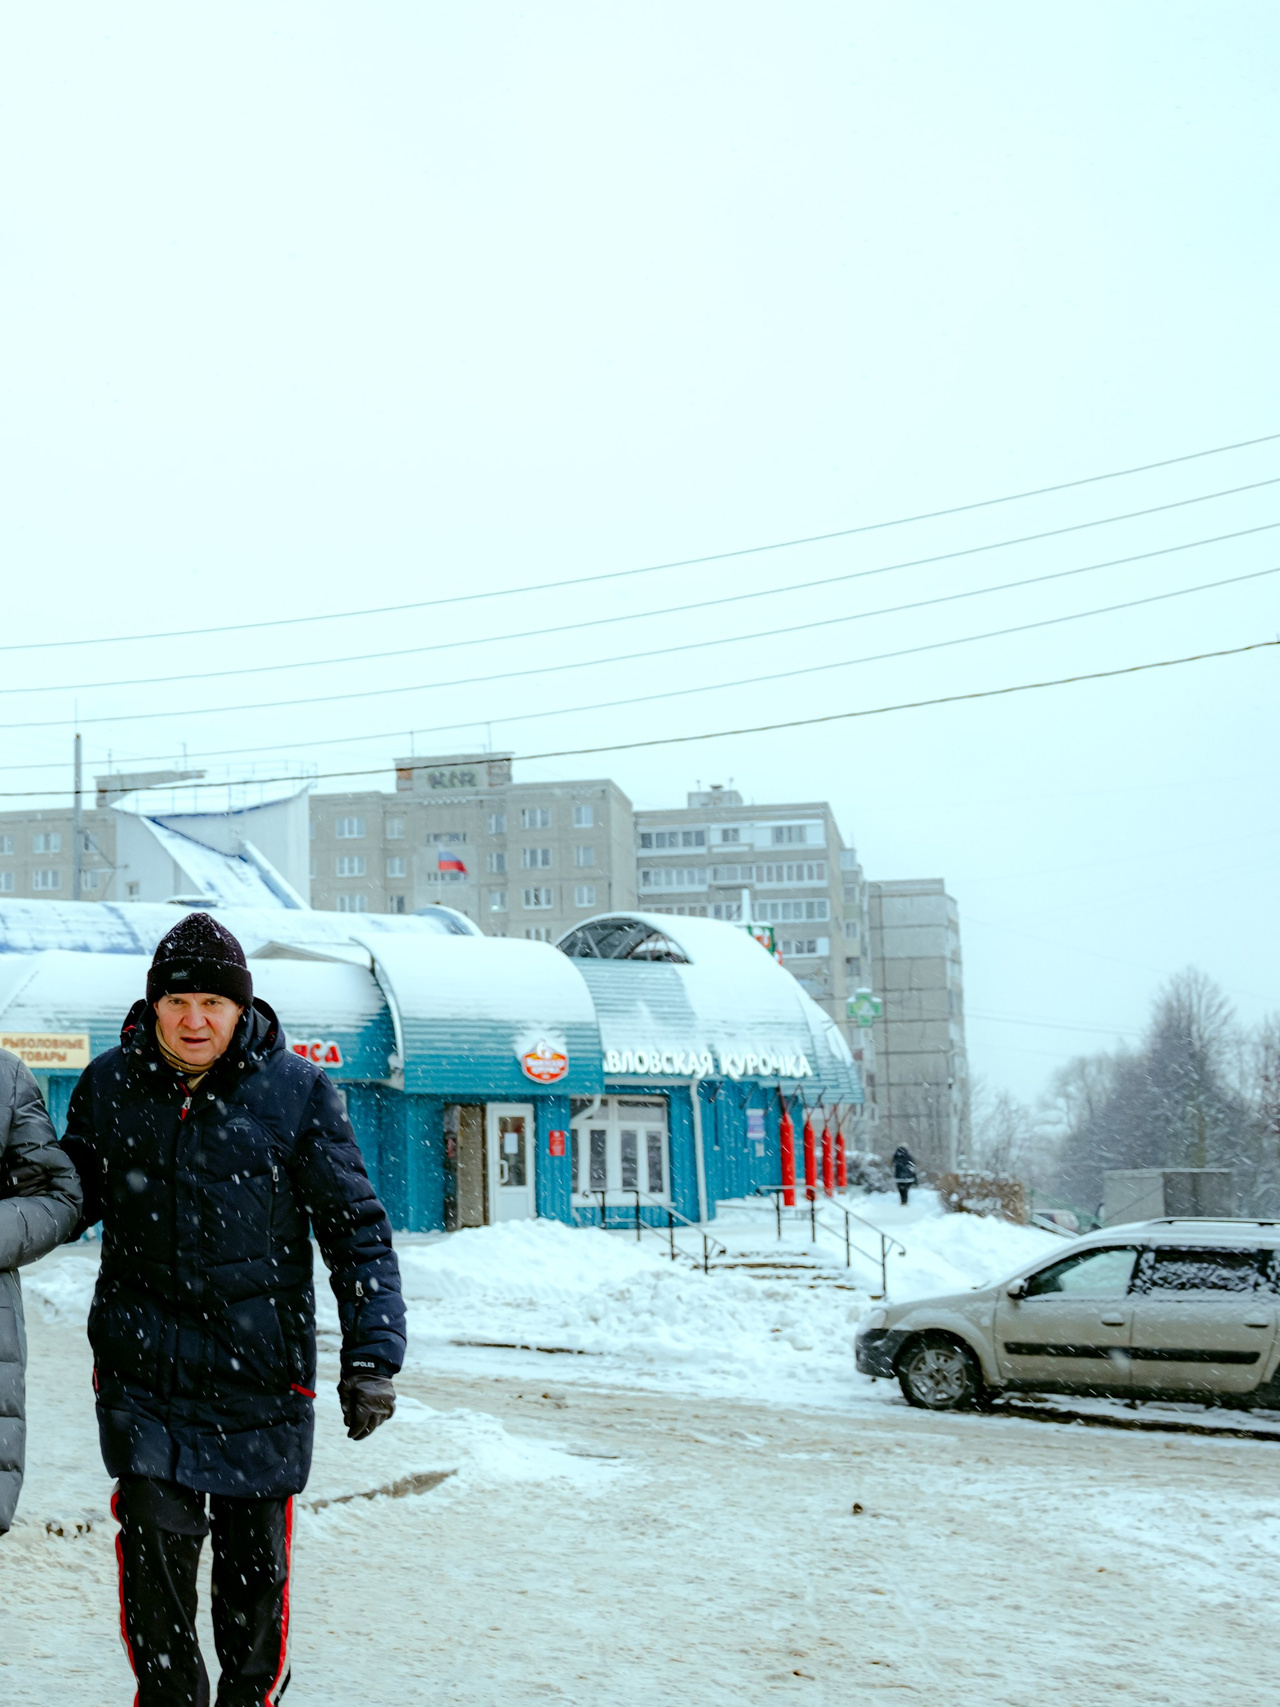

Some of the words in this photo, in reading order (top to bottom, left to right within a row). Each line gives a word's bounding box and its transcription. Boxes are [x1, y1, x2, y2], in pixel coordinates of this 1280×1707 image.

[2, 1038, 84, 1050] РЫБОЛОВНЫЕ
[20, 1051, 67, 1062] ТОВАРЫ
[720, 1052, 813, 1080] КУРОЧКА
